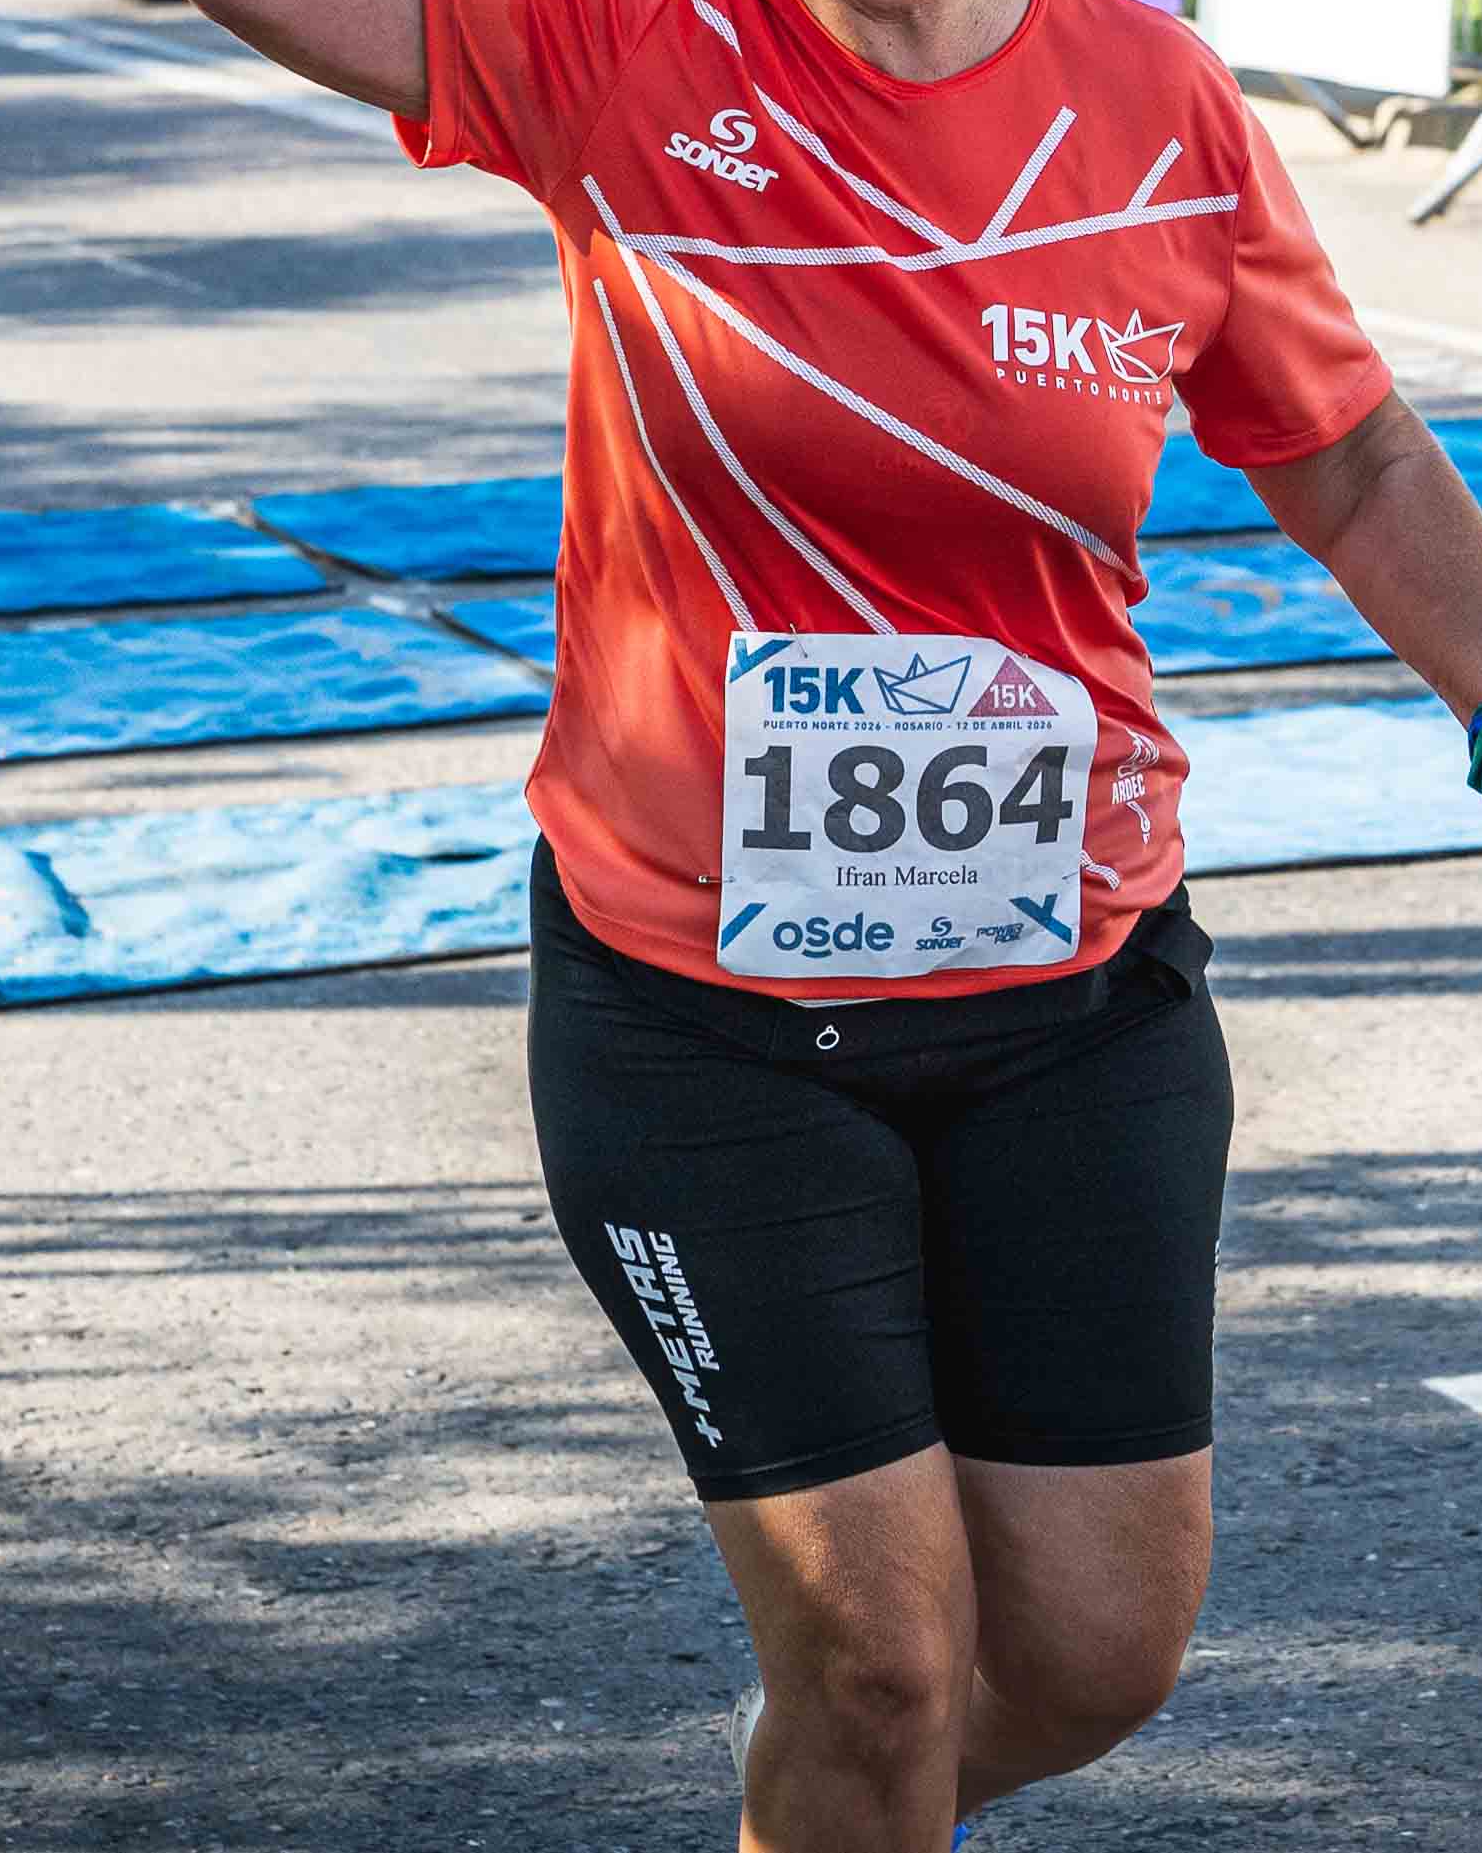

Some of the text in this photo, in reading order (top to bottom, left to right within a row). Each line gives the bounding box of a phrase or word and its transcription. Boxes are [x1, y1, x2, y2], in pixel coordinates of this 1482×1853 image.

[981, 304, 1098, 375] 15K
[995, 367, 1164, 405] PUERTO NORTE
[764, 667, 1036, 714] 15K 15K
[763, 720, 808, 731] PUERTO
[812, 721, 849, 731] NORTE
[854, 721, 882, 731] 2026
[894, 721, 943, 732] ROSARIO
[956, 721, 969, 731] 12
[972, 721, 987, 731] DE
[990, 721, 1023, 731] ABRIL
[1027, 720, 1053, 730] 2026
[741, 744, 1074, 853] 1864
[836, 865, 978, 886] Ifran Marcela
[773, 911, 895, 958] osde
[604, 1221, 711, 1413] METAS
[648, 1230, 720, 1372] RUNNING
